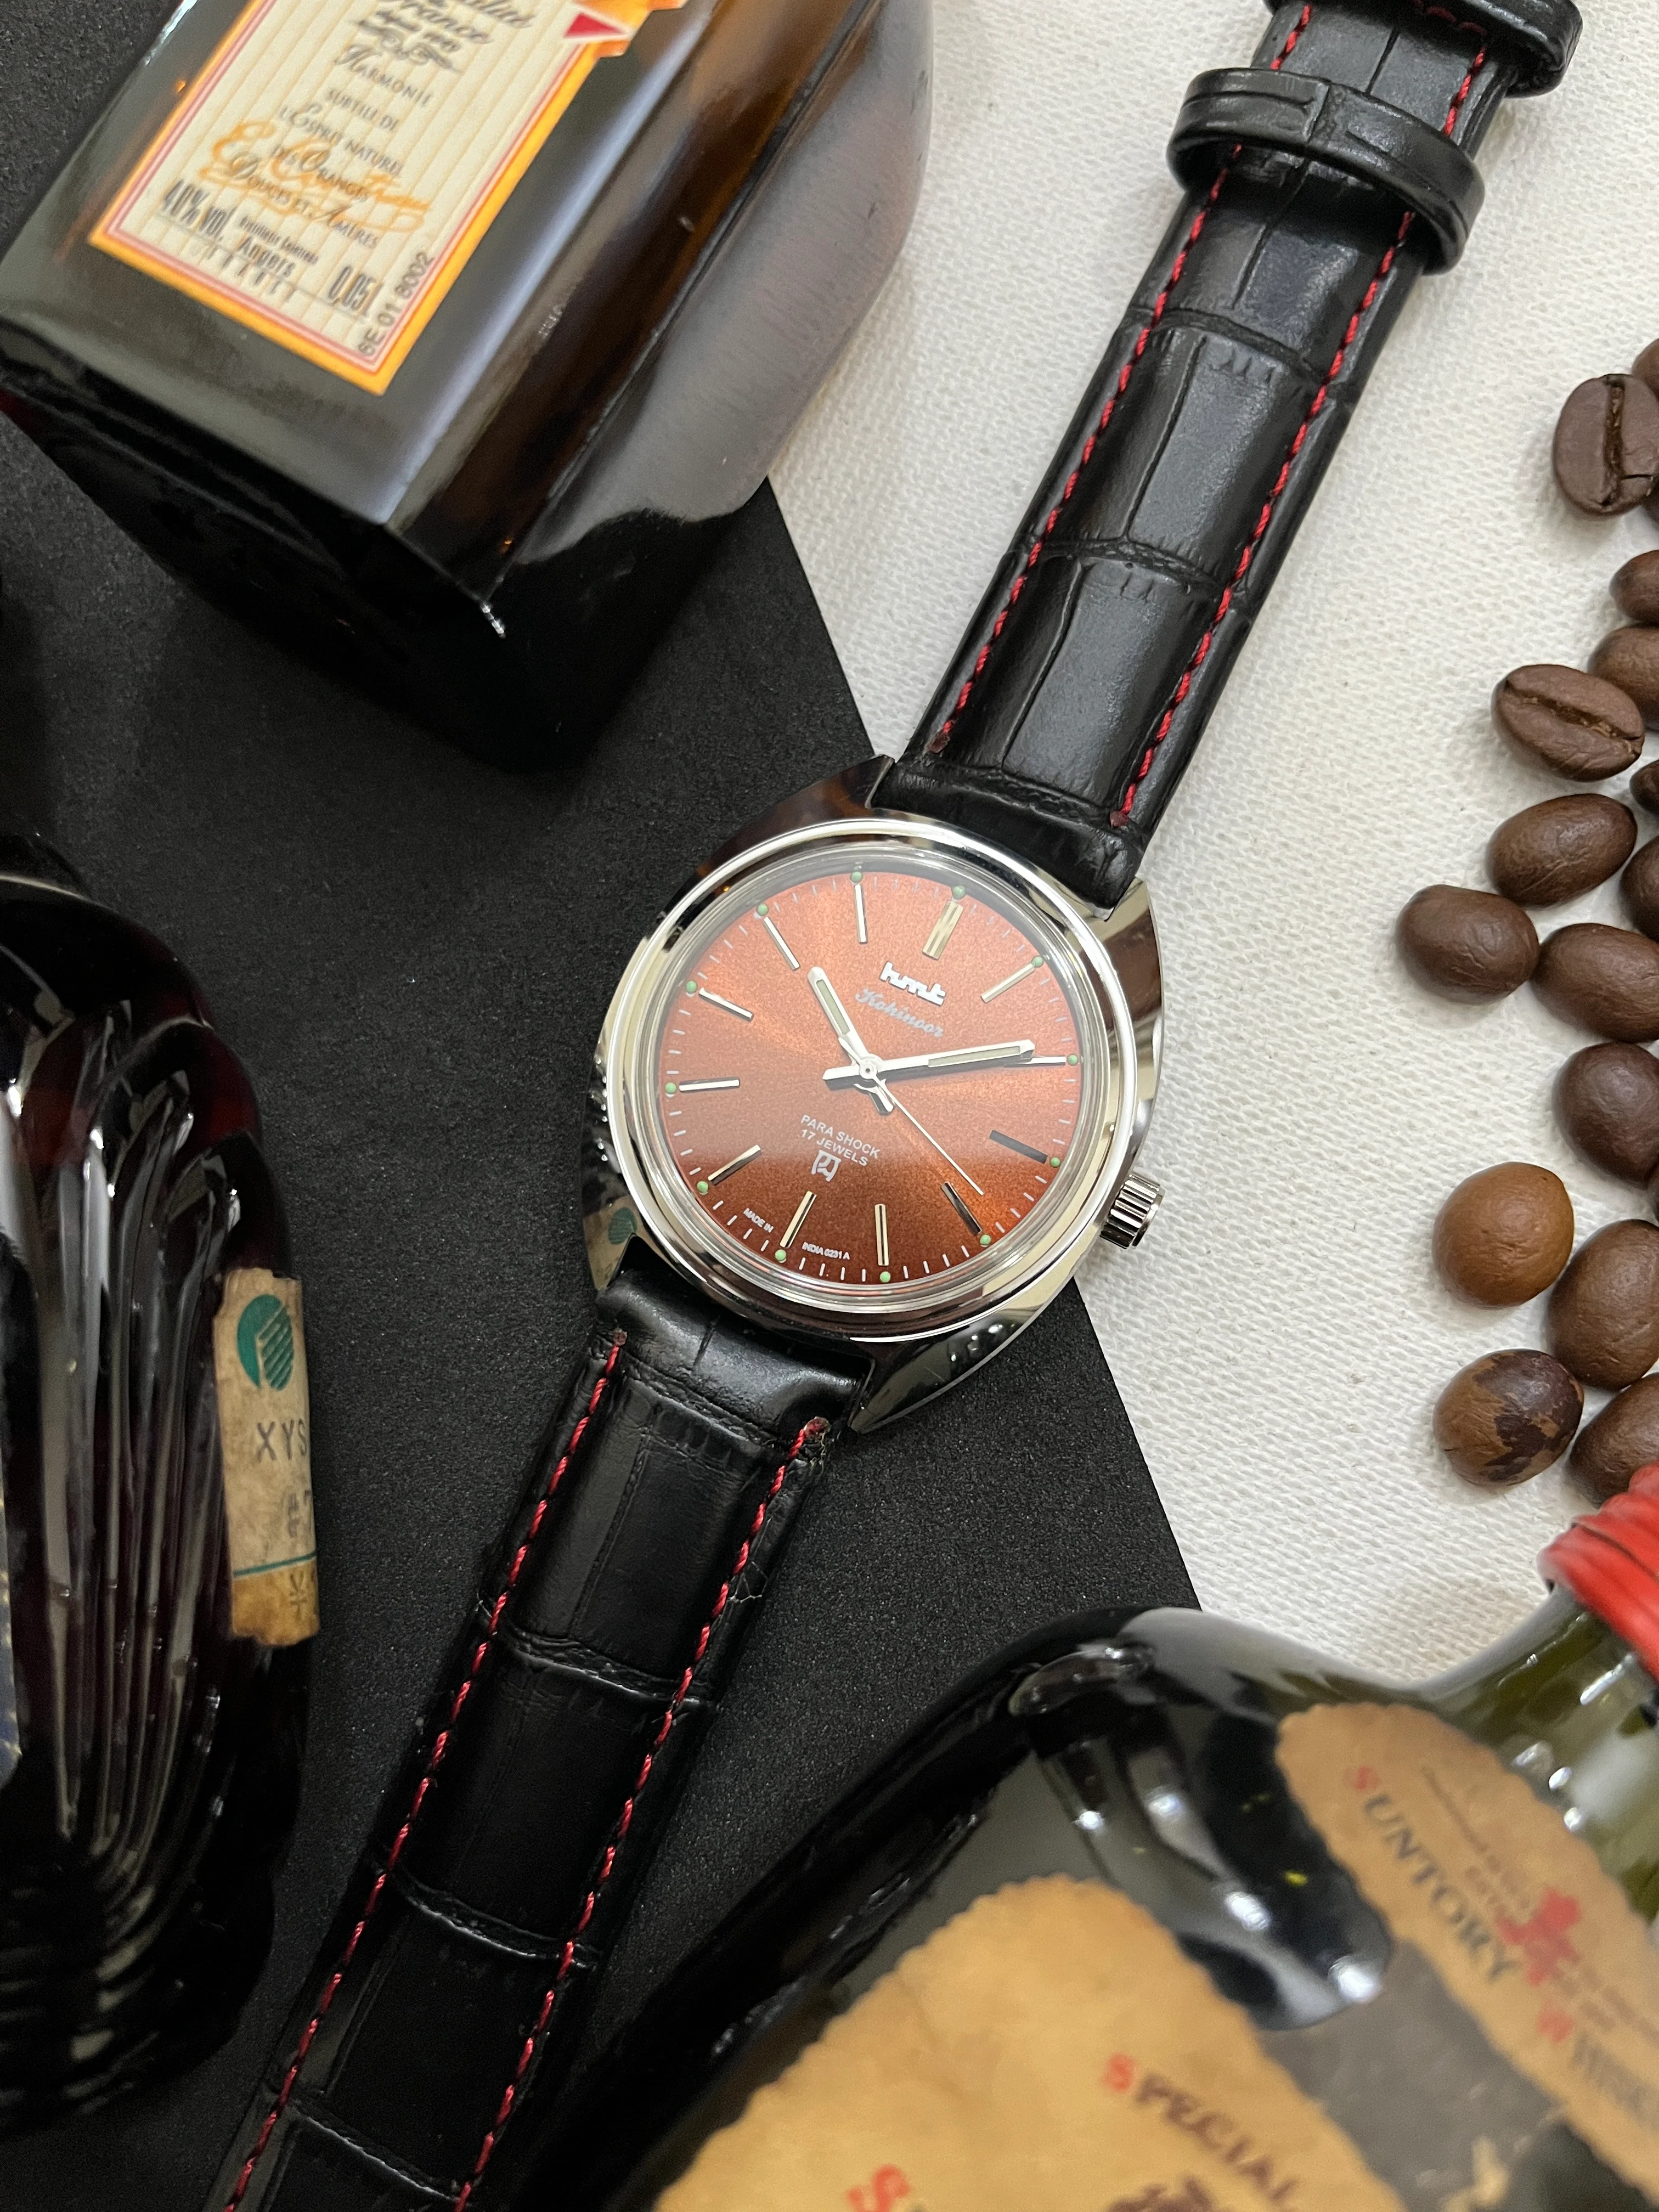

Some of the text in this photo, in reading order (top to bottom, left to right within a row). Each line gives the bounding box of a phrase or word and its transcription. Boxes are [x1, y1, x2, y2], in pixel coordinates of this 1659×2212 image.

[163, 178, 209, 225] 40%
[855, 988, 944, 1037] Kohinoor
[800, 1114, 881, 1159] PARA SHOCK
[802, 1129, 868, 1166] 17 JEWELS
[743, 1207, 765, 1228] MADE
[763, 1223, 774, 1233] IN
[802, 1242, 823, 1255] INDIA
